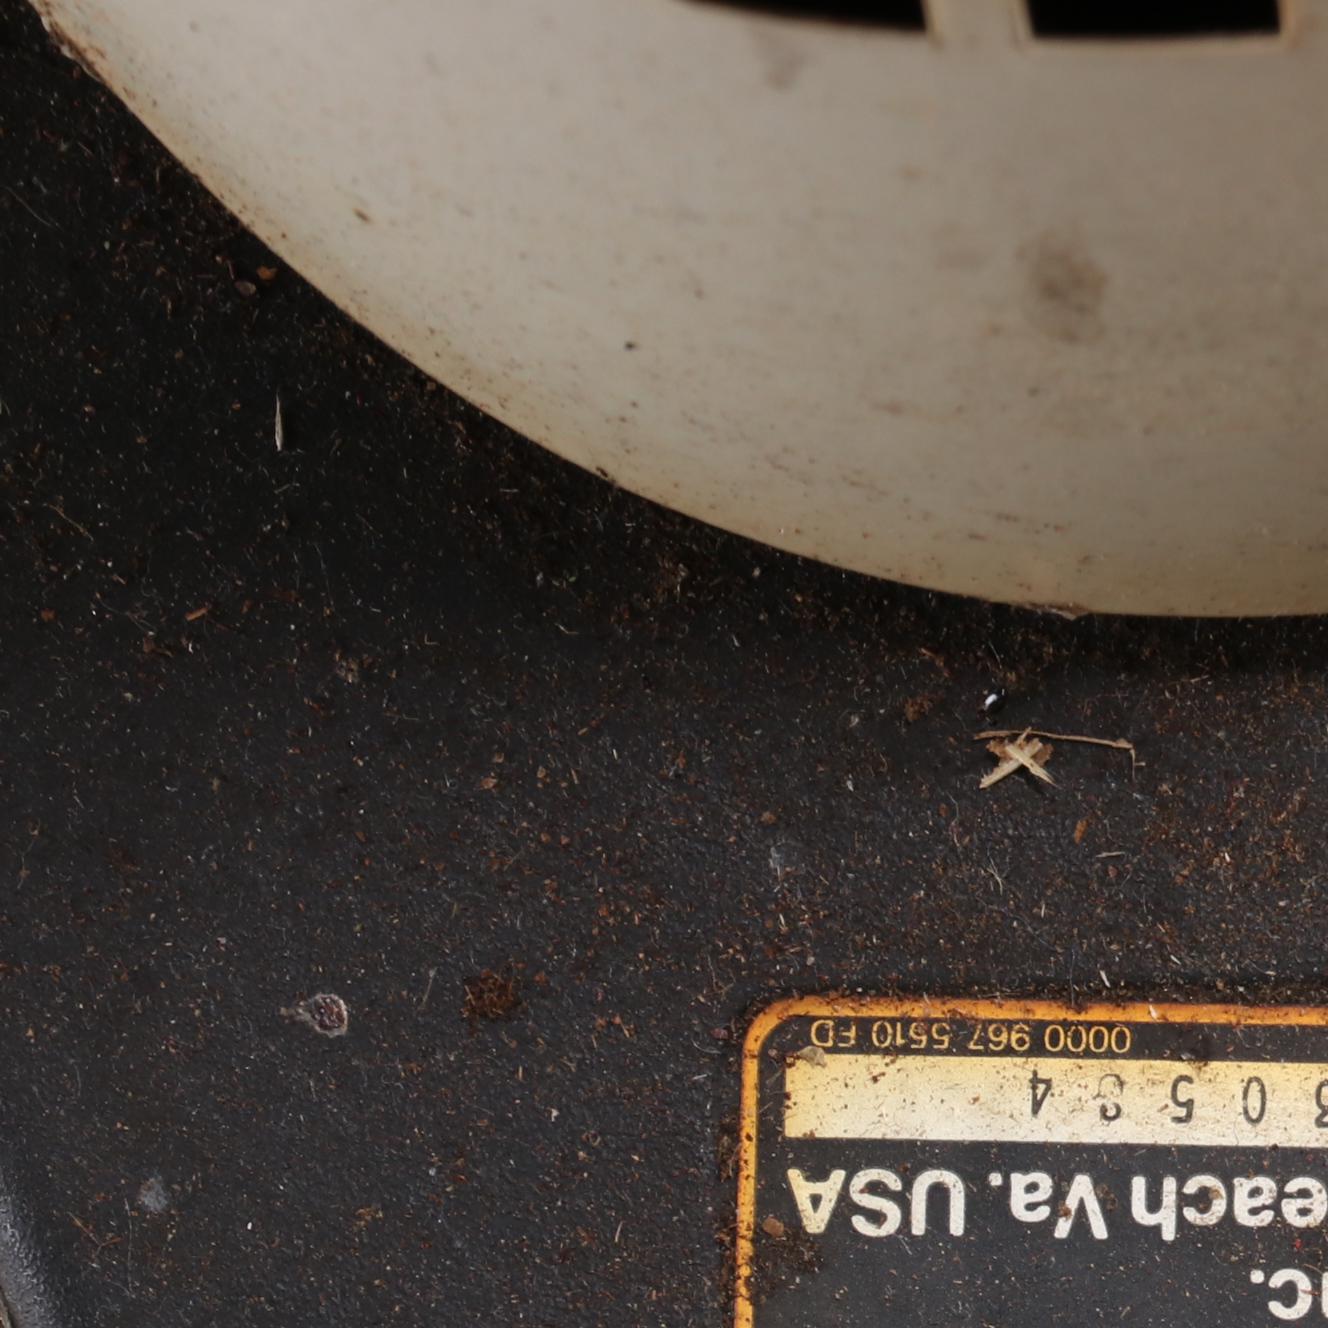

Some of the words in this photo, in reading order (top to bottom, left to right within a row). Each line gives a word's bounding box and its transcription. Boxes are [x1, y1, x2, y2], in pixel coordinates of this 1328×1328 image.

[809, 1018, 858, 1050] FD
[967, 1019, 1031, 1052] 967
[1043, 1025, 1132, 1055] 0000
[788, 1169, 965, 1237] USA
[989, 1172, 1108, 1239] Va.
